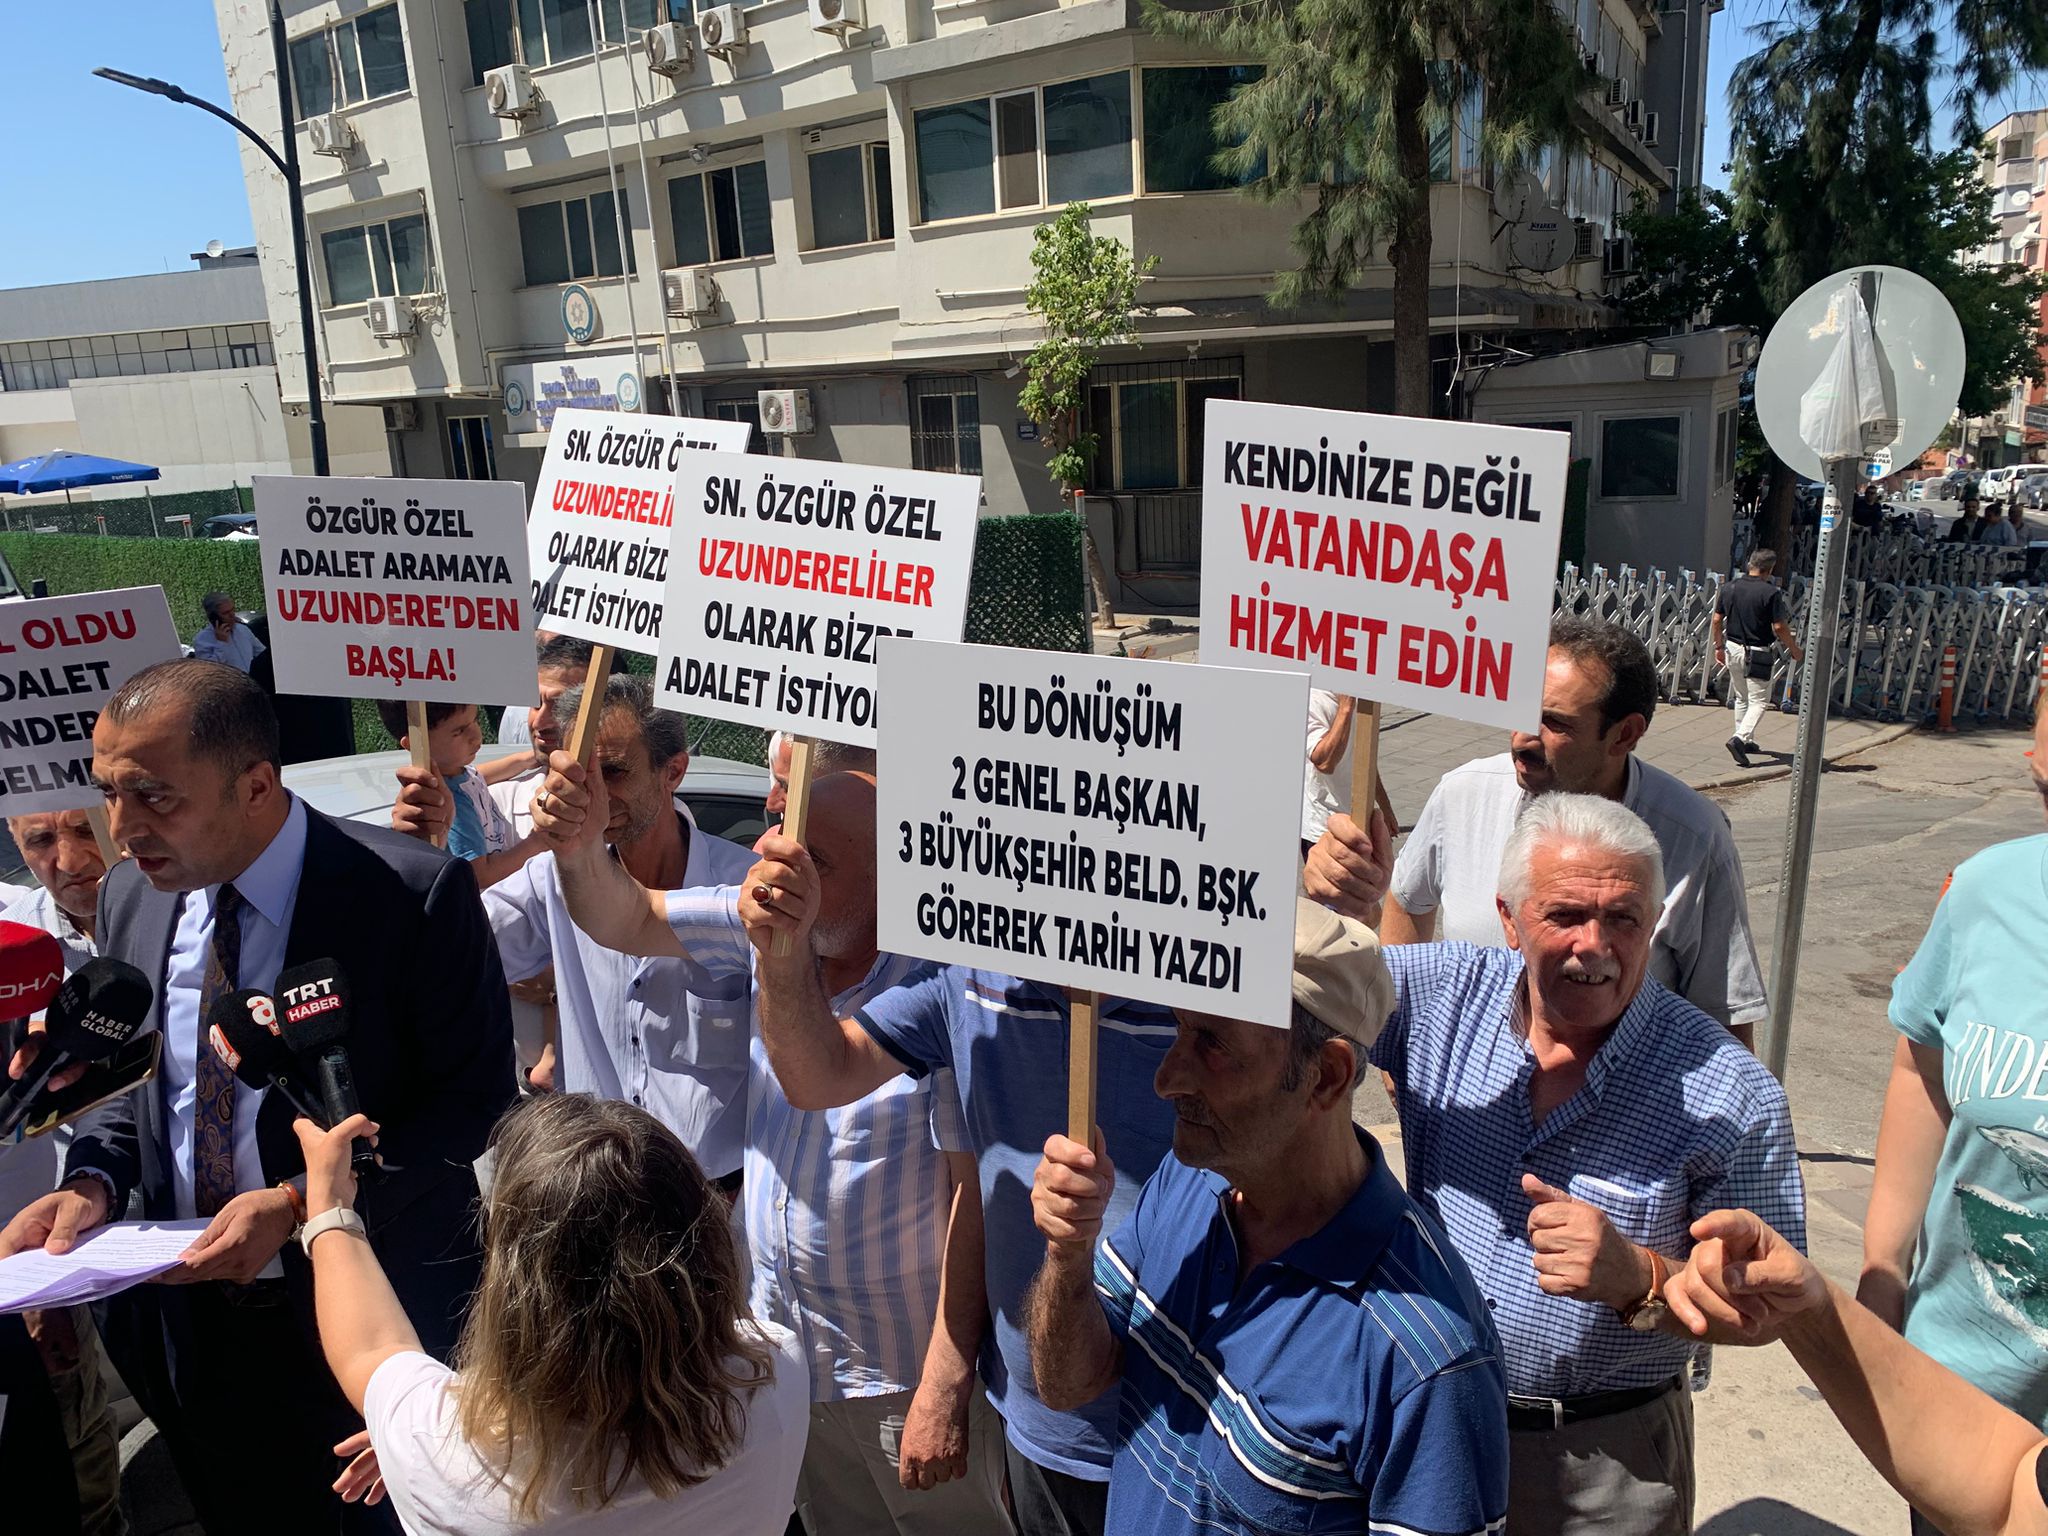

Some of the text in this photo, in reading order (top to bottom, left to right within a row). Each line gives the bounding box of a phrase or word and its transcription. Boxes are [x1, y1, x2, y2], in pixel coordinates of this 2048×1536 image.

[564, 429, 591, 462] SN.
[597, 425, 665, 470] ÖZGÜR
[1224, 436, 1541, 523] KENDİNİZE DEĞİL
[306, 496, 473, 538] ÖZGÜR ÖZEL
[703, 473, 942, 542] SN. ÖZGÜR ÖZEL
[279, 548, 512, 584] ADALET ARAMAYA
[548, 531, 624, 574] OLARAK
[699, 537, 935, 607] UZUNDERELİLER
[1240, 503, 1510, 610] VATANDAŞA
[22, 609, 137, 650] OLDU
[277, 589, 520, 631] UZUNDERE'DEN
[704, 600, 818, 654] OLARAK
[346, 644, 457, 686] BAŞLA!
[1229, 581, 1513, 702] HİZMET EDİN
[665, 656, 877, 729] ADALET İSTİYO
[978, 674, 1182, 757] BU DÖNÜŞÜM
[951, 756, 1207, 842] 2 GENEL BAŞKAN,
[899, 811, 1267, 926] 3 BÜYÜKŞEHİR BELD. BŞK.
[917, 881, 1242, 993] GÖREREK TARİH YAZDI
[283, 978, 333, 1006] TRT
[289, 997, 340, 1022] HABER
[80, 1019, 124, 1041] GLOBAL
[86, 1010, 132, 1034] HABER
